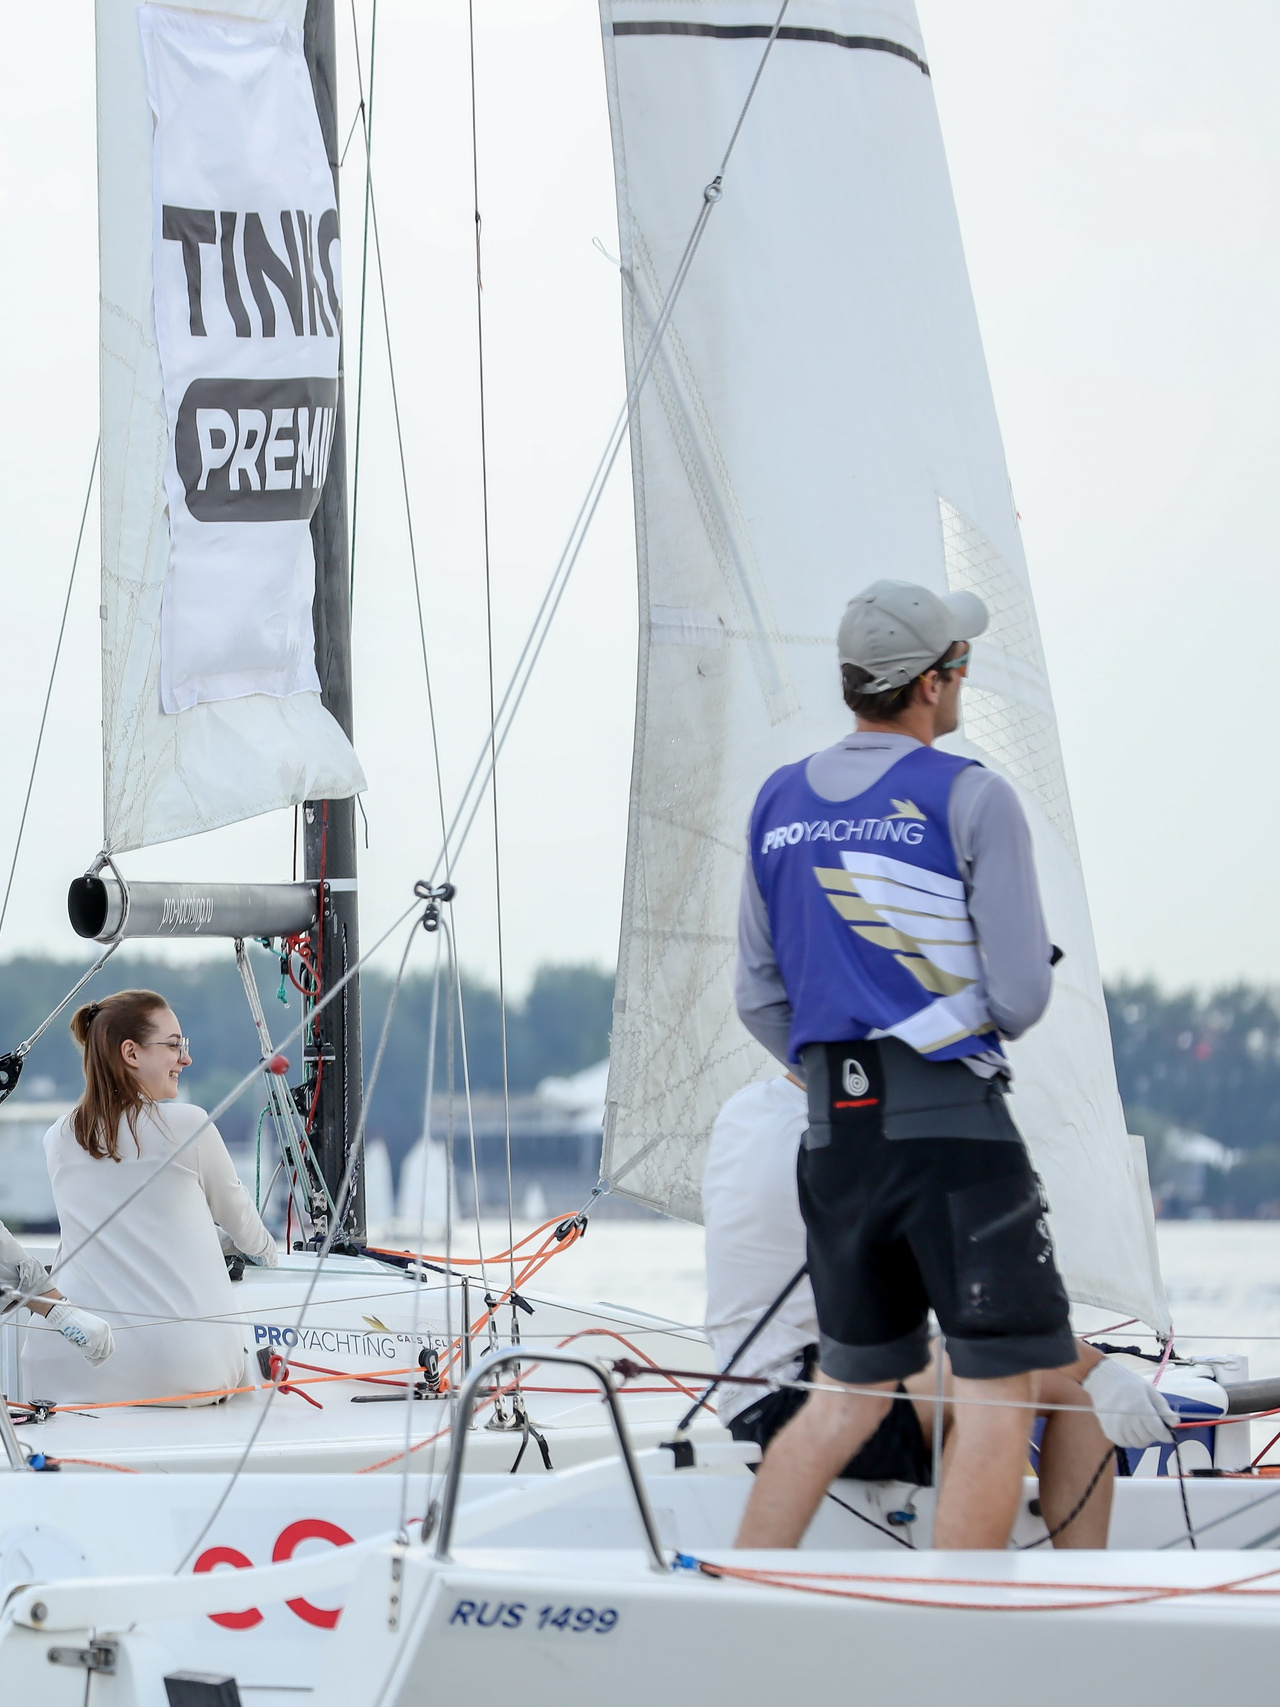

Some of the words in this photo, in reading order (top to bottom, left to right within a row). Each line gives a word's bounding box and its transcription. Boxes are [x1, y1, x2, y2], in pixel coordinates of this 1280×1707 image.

[761, 818, 926, 855] PROYACHTING
[253, 1325, 396, 1359] PROYACHTING
[434, 1339, 462, 1349] CL
[448, 1600, 528, 1629] RUS
[536, 1605, 620, 1635] 1499
